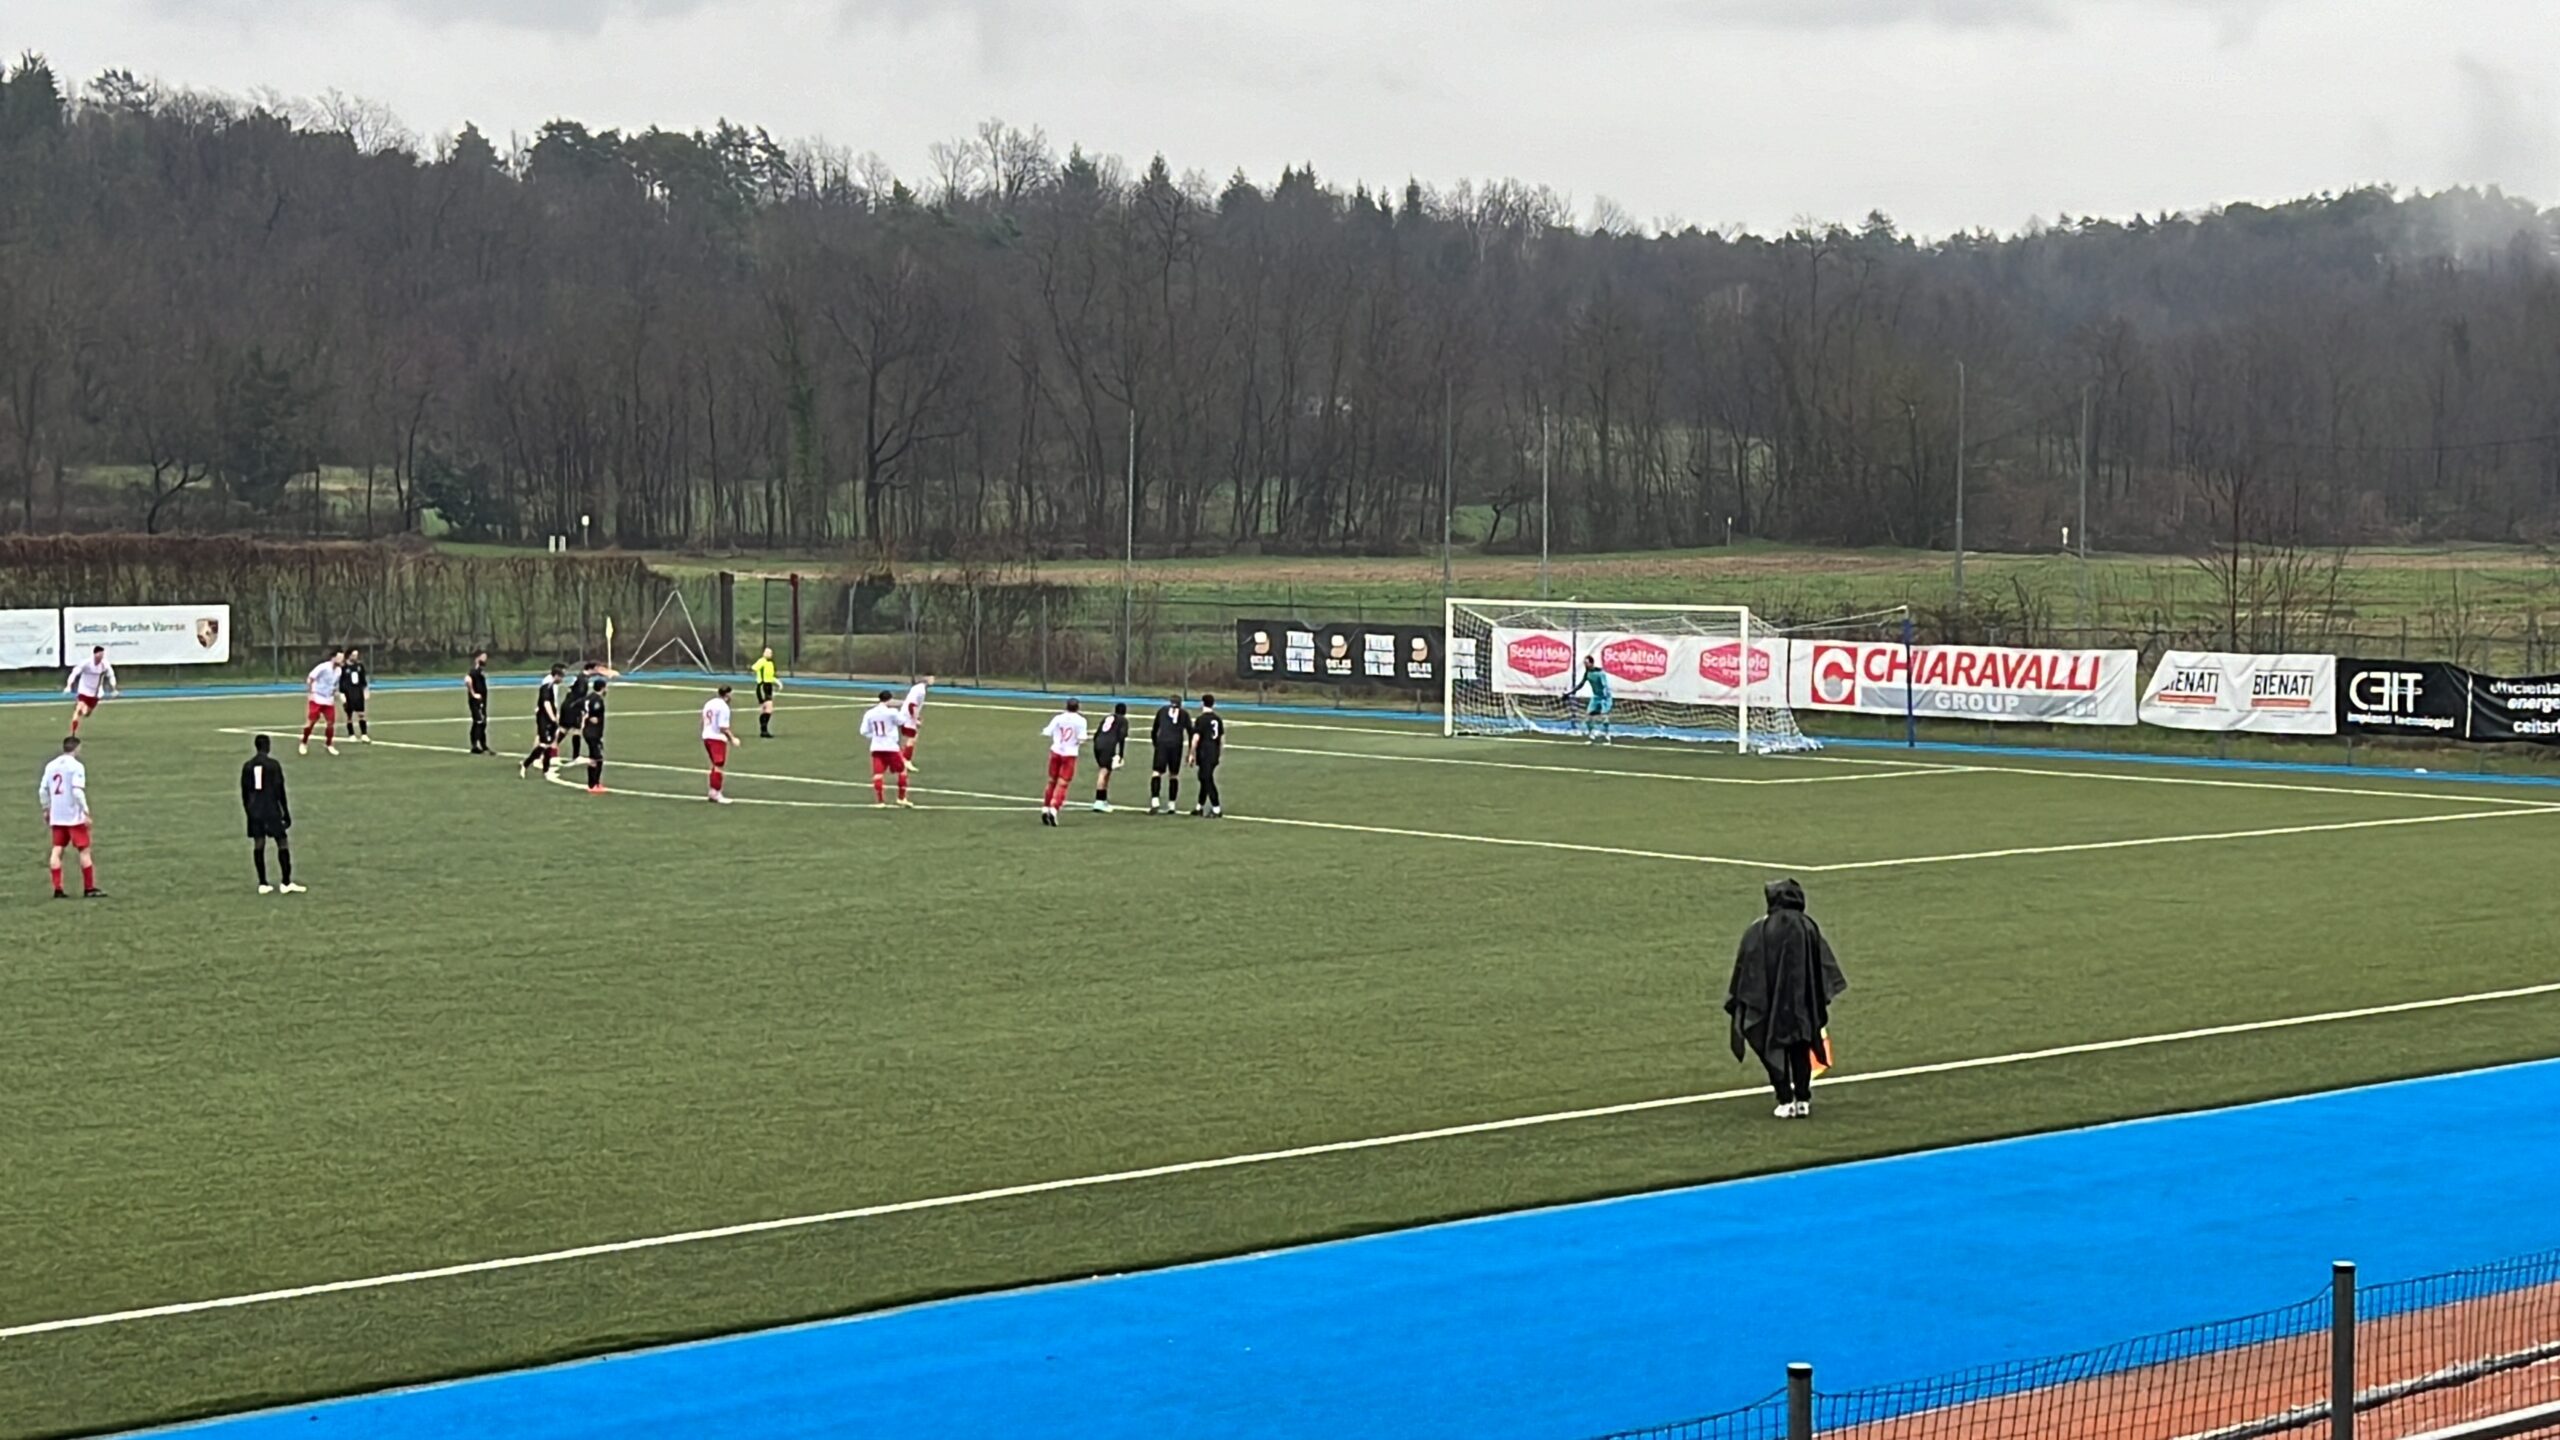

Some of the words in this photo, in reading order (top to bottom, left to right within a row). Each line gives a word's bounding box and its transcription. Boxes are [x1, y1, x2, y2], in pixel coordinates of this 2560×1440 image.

[74, 623, 108, 633] Centro
[111, 622, 150, 632] Porsche
[153, 621, 187, 632] Varese
[1863, 648, 2102, 692] CHIARAVALLI
[2252, 674, 2314, 697] BIENATI
[1934, 692, 2021, 713] GROUP
[1167, 706, 1179, 724] 4
[872, 720, 886, 738] 11
[1059, 727, 1073, 743] 10
[1209, 719, 1219, 740] 3
[52, 773, 63, 795] 2
[253, 765, 263, 790] 1
